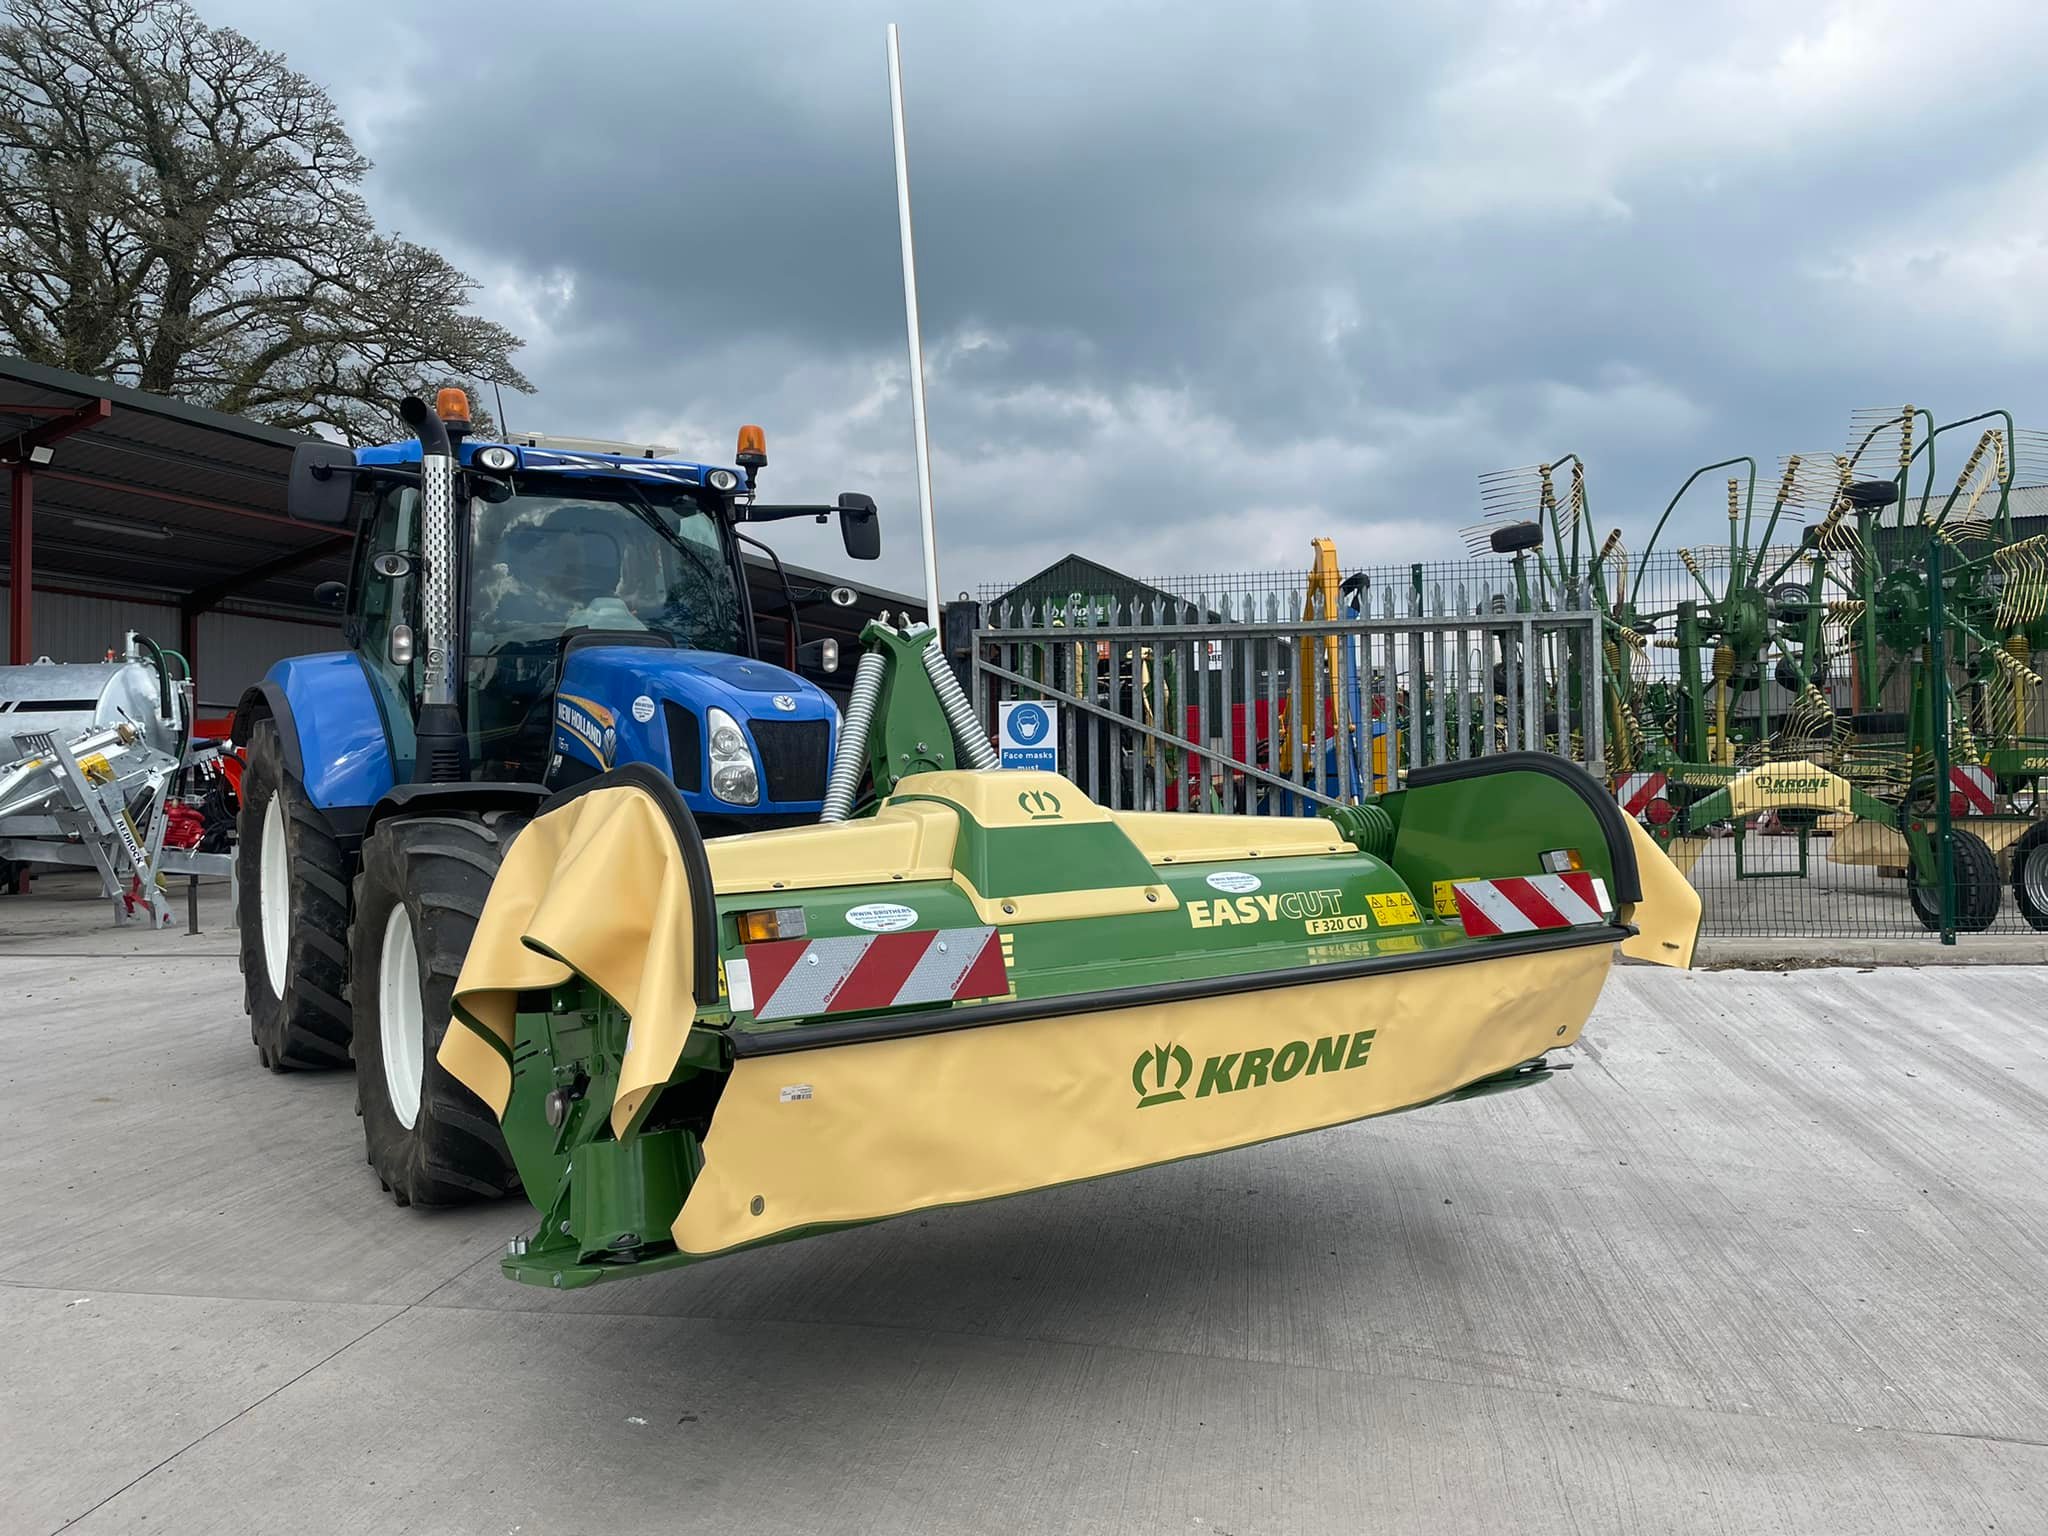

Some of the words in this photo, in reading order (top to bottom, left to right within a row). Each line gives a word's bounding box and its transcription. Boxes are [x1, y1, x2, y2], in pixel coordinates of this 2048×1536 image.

[558, 702, 571, 724] NEW
[571, 709, 602, 748] HOLLAND
[1003, 751, 1024, 760] Face
[1025, 751, 1053, 760] masks
[1773, 778, 1830, 788] KRONE
[116, 820, 145, 865] REDROCK
[1186, 889, 1343, 929] EASYCUT
[1312, 921, 1320, 933] F
[1323, 919, 1344, 932] 320
[1347, 916, 1363, 929] CV
[1195, 1029, 1377, 1098] KRONE
